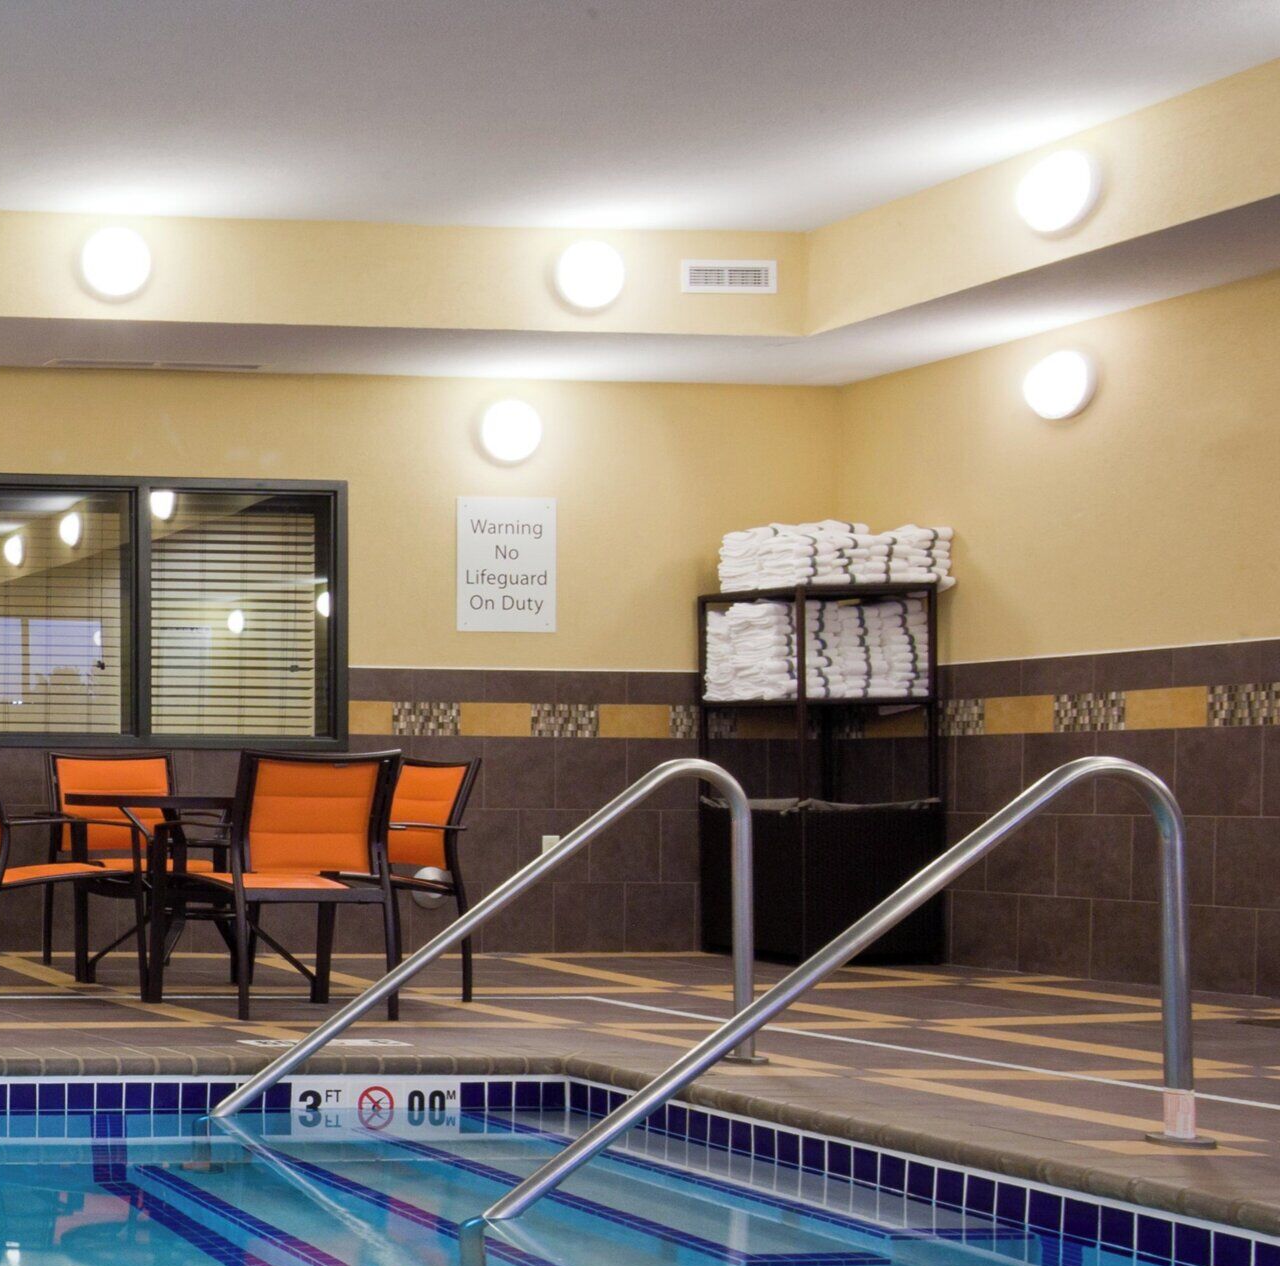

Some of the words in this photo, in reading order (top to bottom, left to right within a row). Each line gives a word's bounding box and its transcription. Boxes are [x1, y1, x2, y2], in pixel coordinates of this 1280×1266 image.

[470, 519, 543, 539] Warning
[495, 545, 519, 560] No
[466, 569, 547, 589] Lifeguard
[470, 594, 495, 610] On
[502, 595, 544, 615] Duty
[299, 1089, 322, 1111] 3
[326, 1089, 342, 1102] FT
[446, 1090, 456, 1100] M
